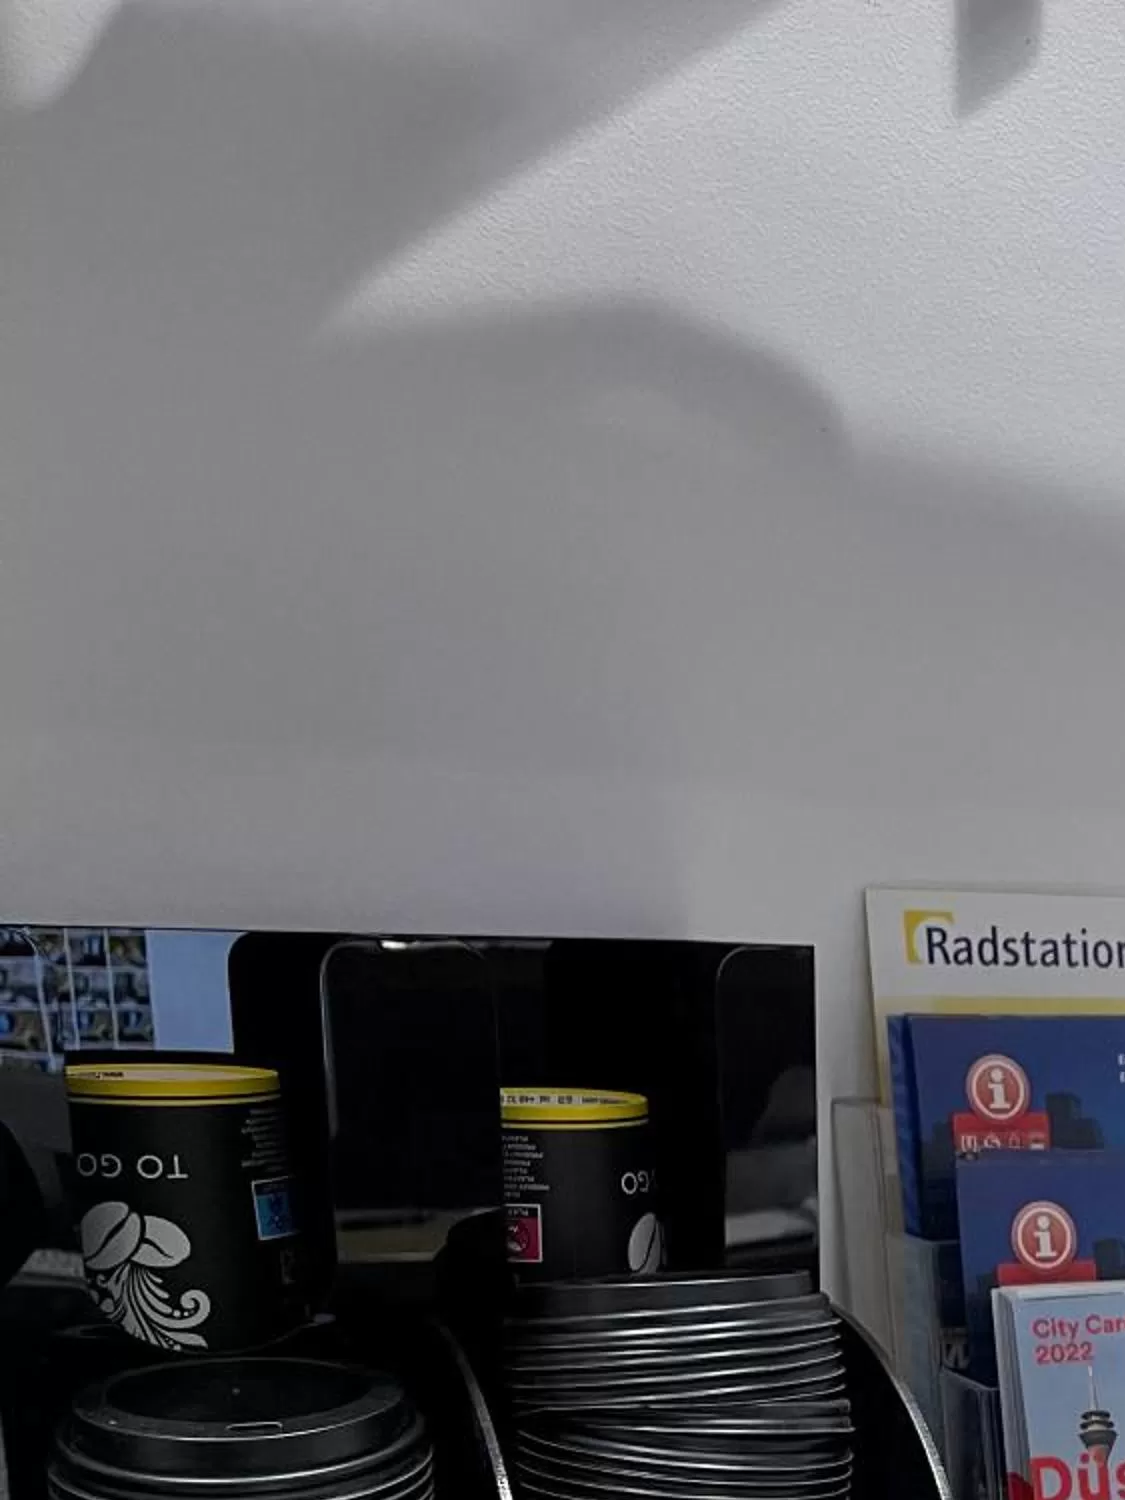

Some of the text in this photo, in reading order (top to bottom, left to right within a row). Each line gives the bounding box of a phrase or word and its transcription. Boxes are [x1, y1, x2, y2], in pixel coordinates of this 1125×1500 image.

[77, 1152, 189, 1179] TO GO
[1032, 1316, 1079, 1340] City
[1035, 1341, 1094, 1364] 2022
